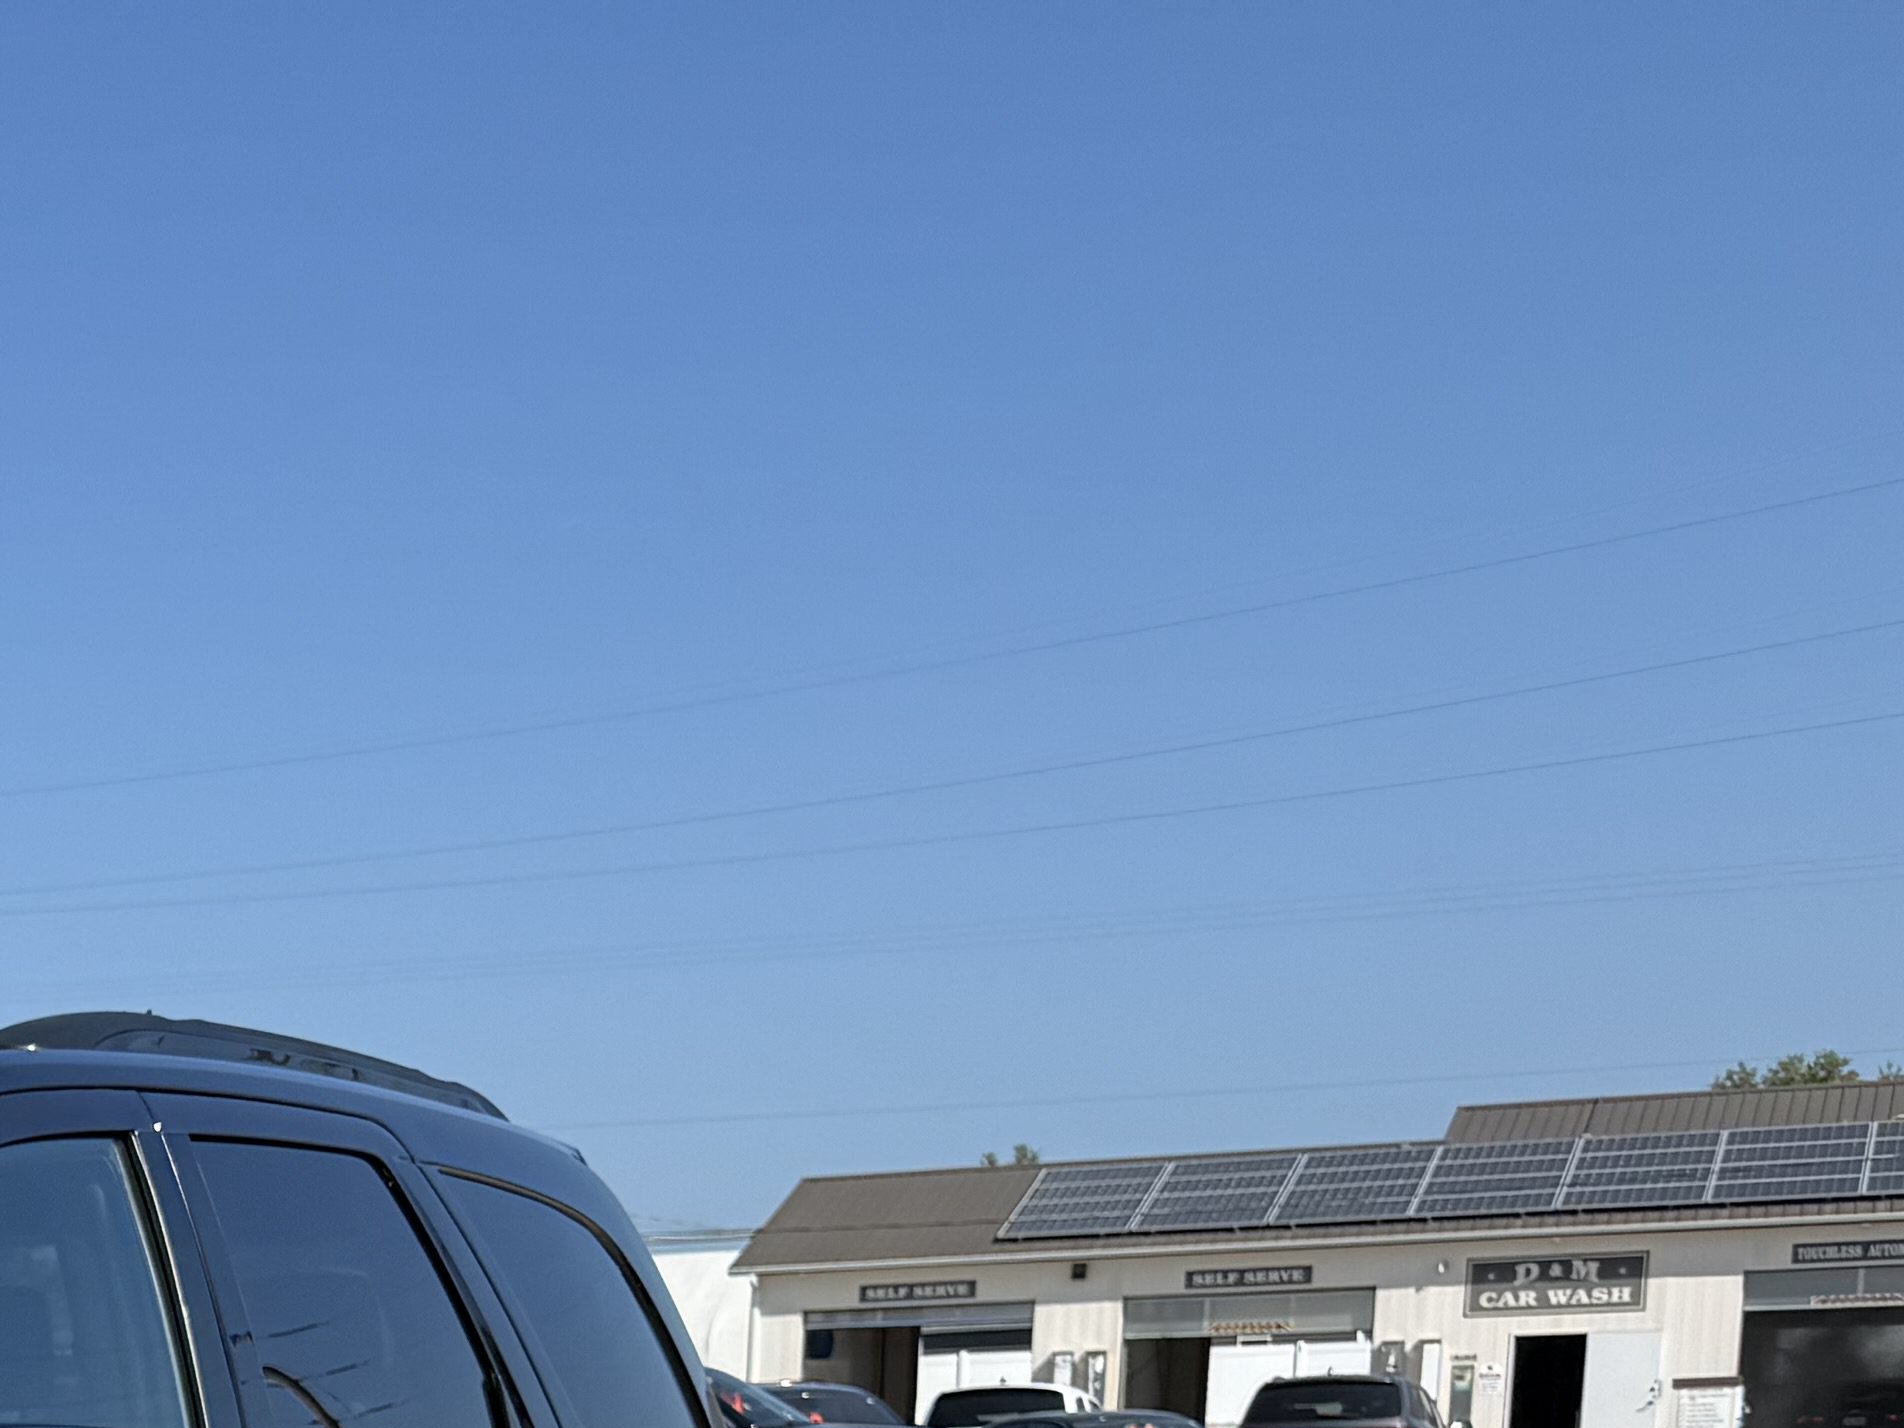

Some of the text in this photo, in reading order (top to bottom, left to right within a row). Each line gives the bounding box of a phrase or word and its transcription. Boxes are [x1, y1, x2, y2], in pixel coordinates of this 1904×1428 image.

[1797, 1245, 1862, 1260] TOUCHLESS
[1192, 1268, 1305, 1286] SELF SERVE
[1513, 1260, 1601, 1286] D & M
[865, 1283, 971, 1300] SELF SERVE
[1478, 1286, 1633, 1308] CAR WASH
